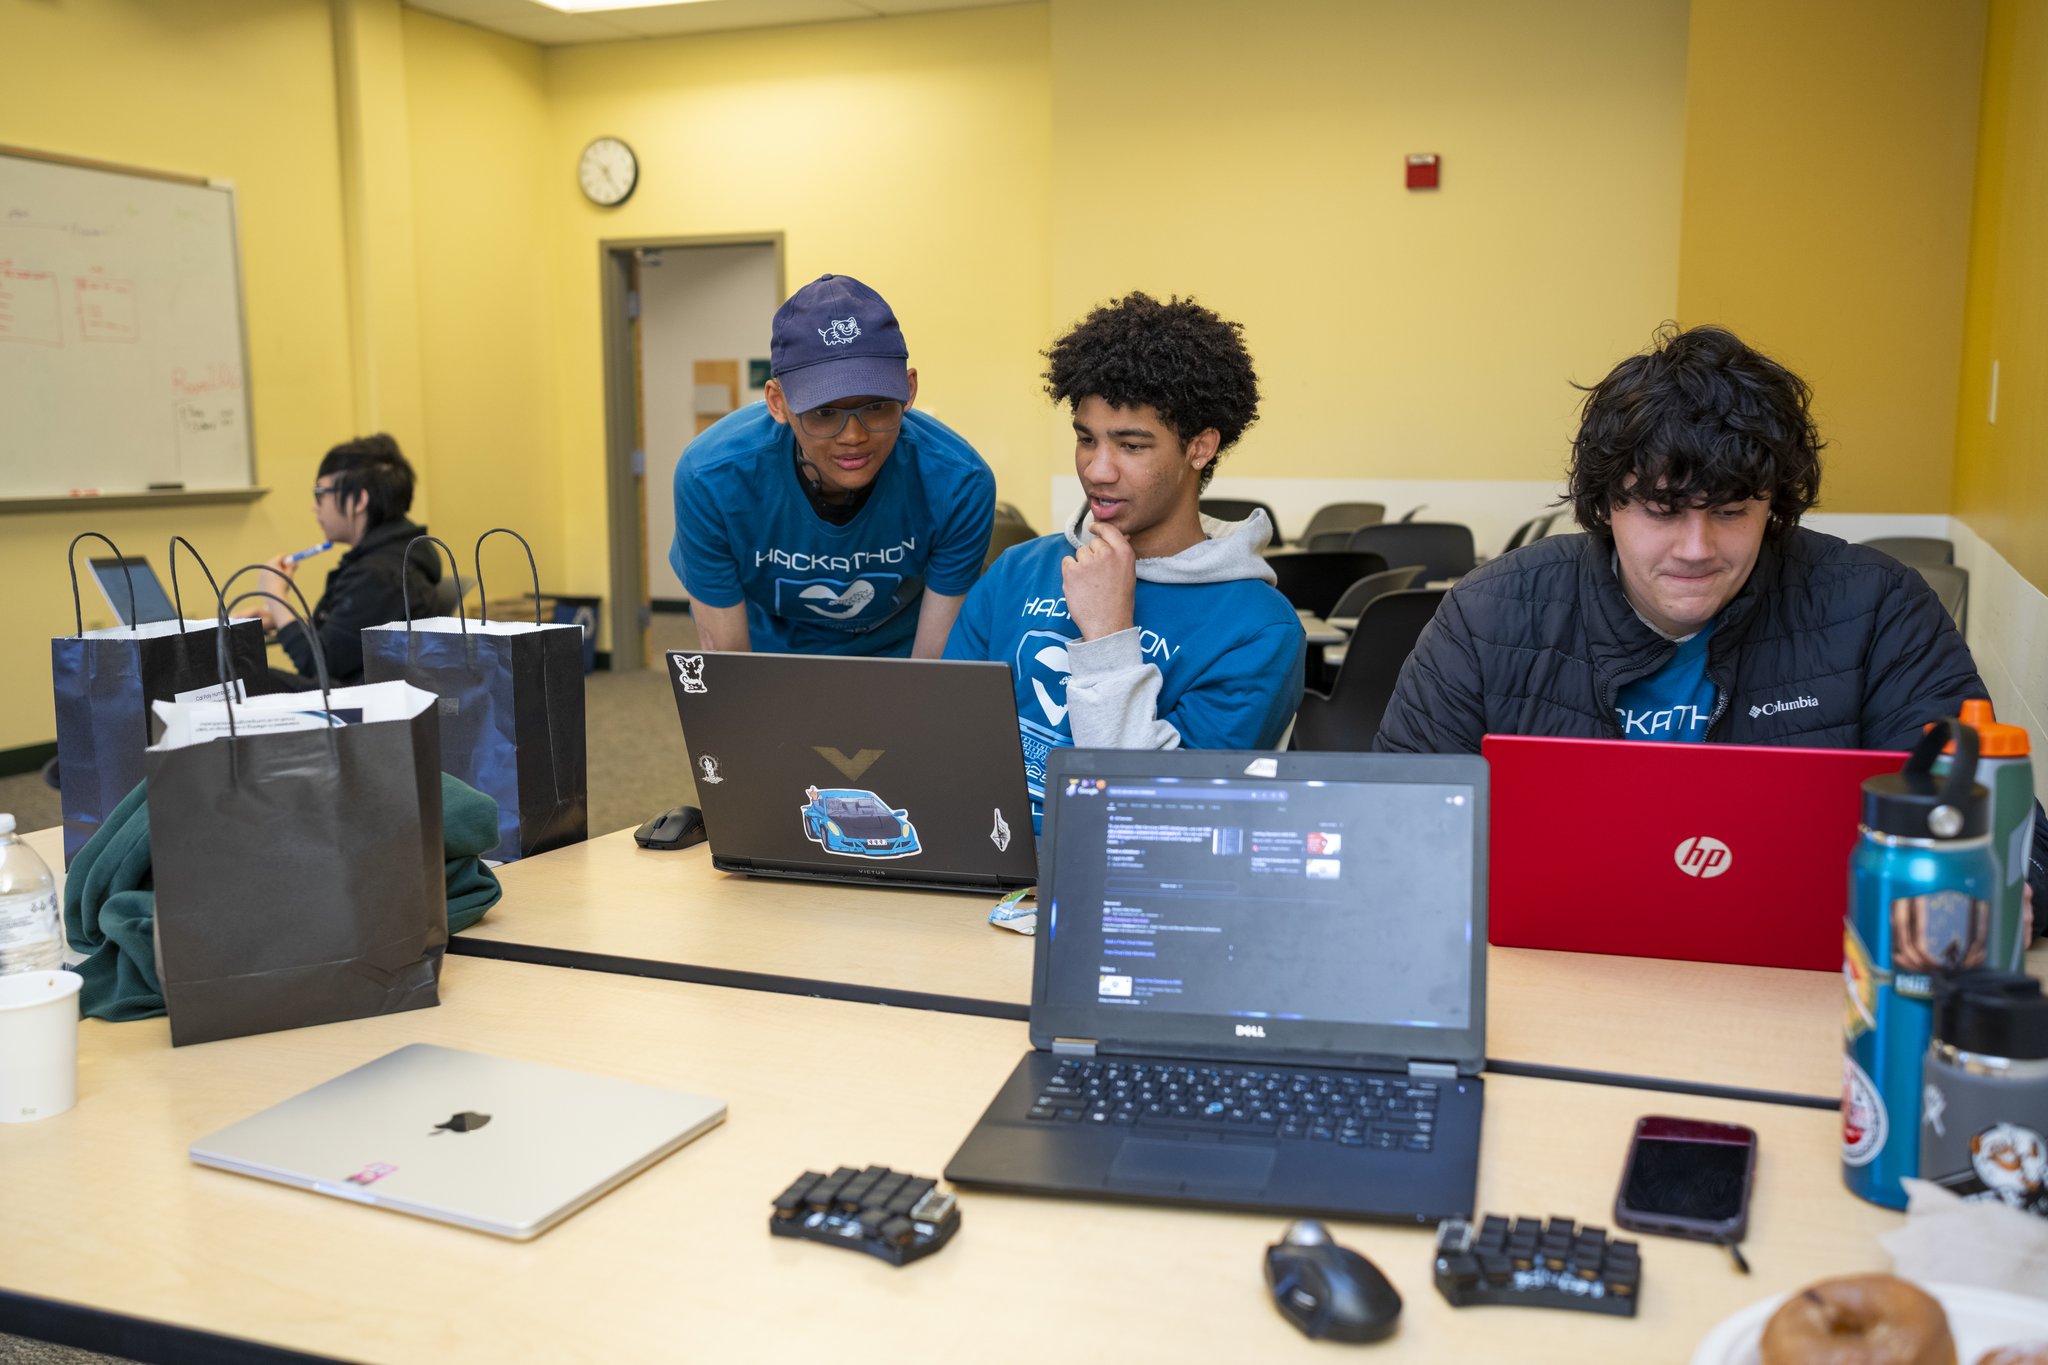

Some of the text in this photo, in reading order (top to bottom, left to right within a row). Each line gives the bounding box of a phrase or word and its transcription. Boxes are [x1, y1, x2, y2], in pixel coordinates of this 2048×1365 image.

[755, 537, 915, 573] HACKATHON
[1021, 597, 1181, 661] HACON
[1762, 695, 1820, 717] Columbia
[1678, 836, 1730, 878] hp
[1235, 1024, 1266, 1038] DELL
